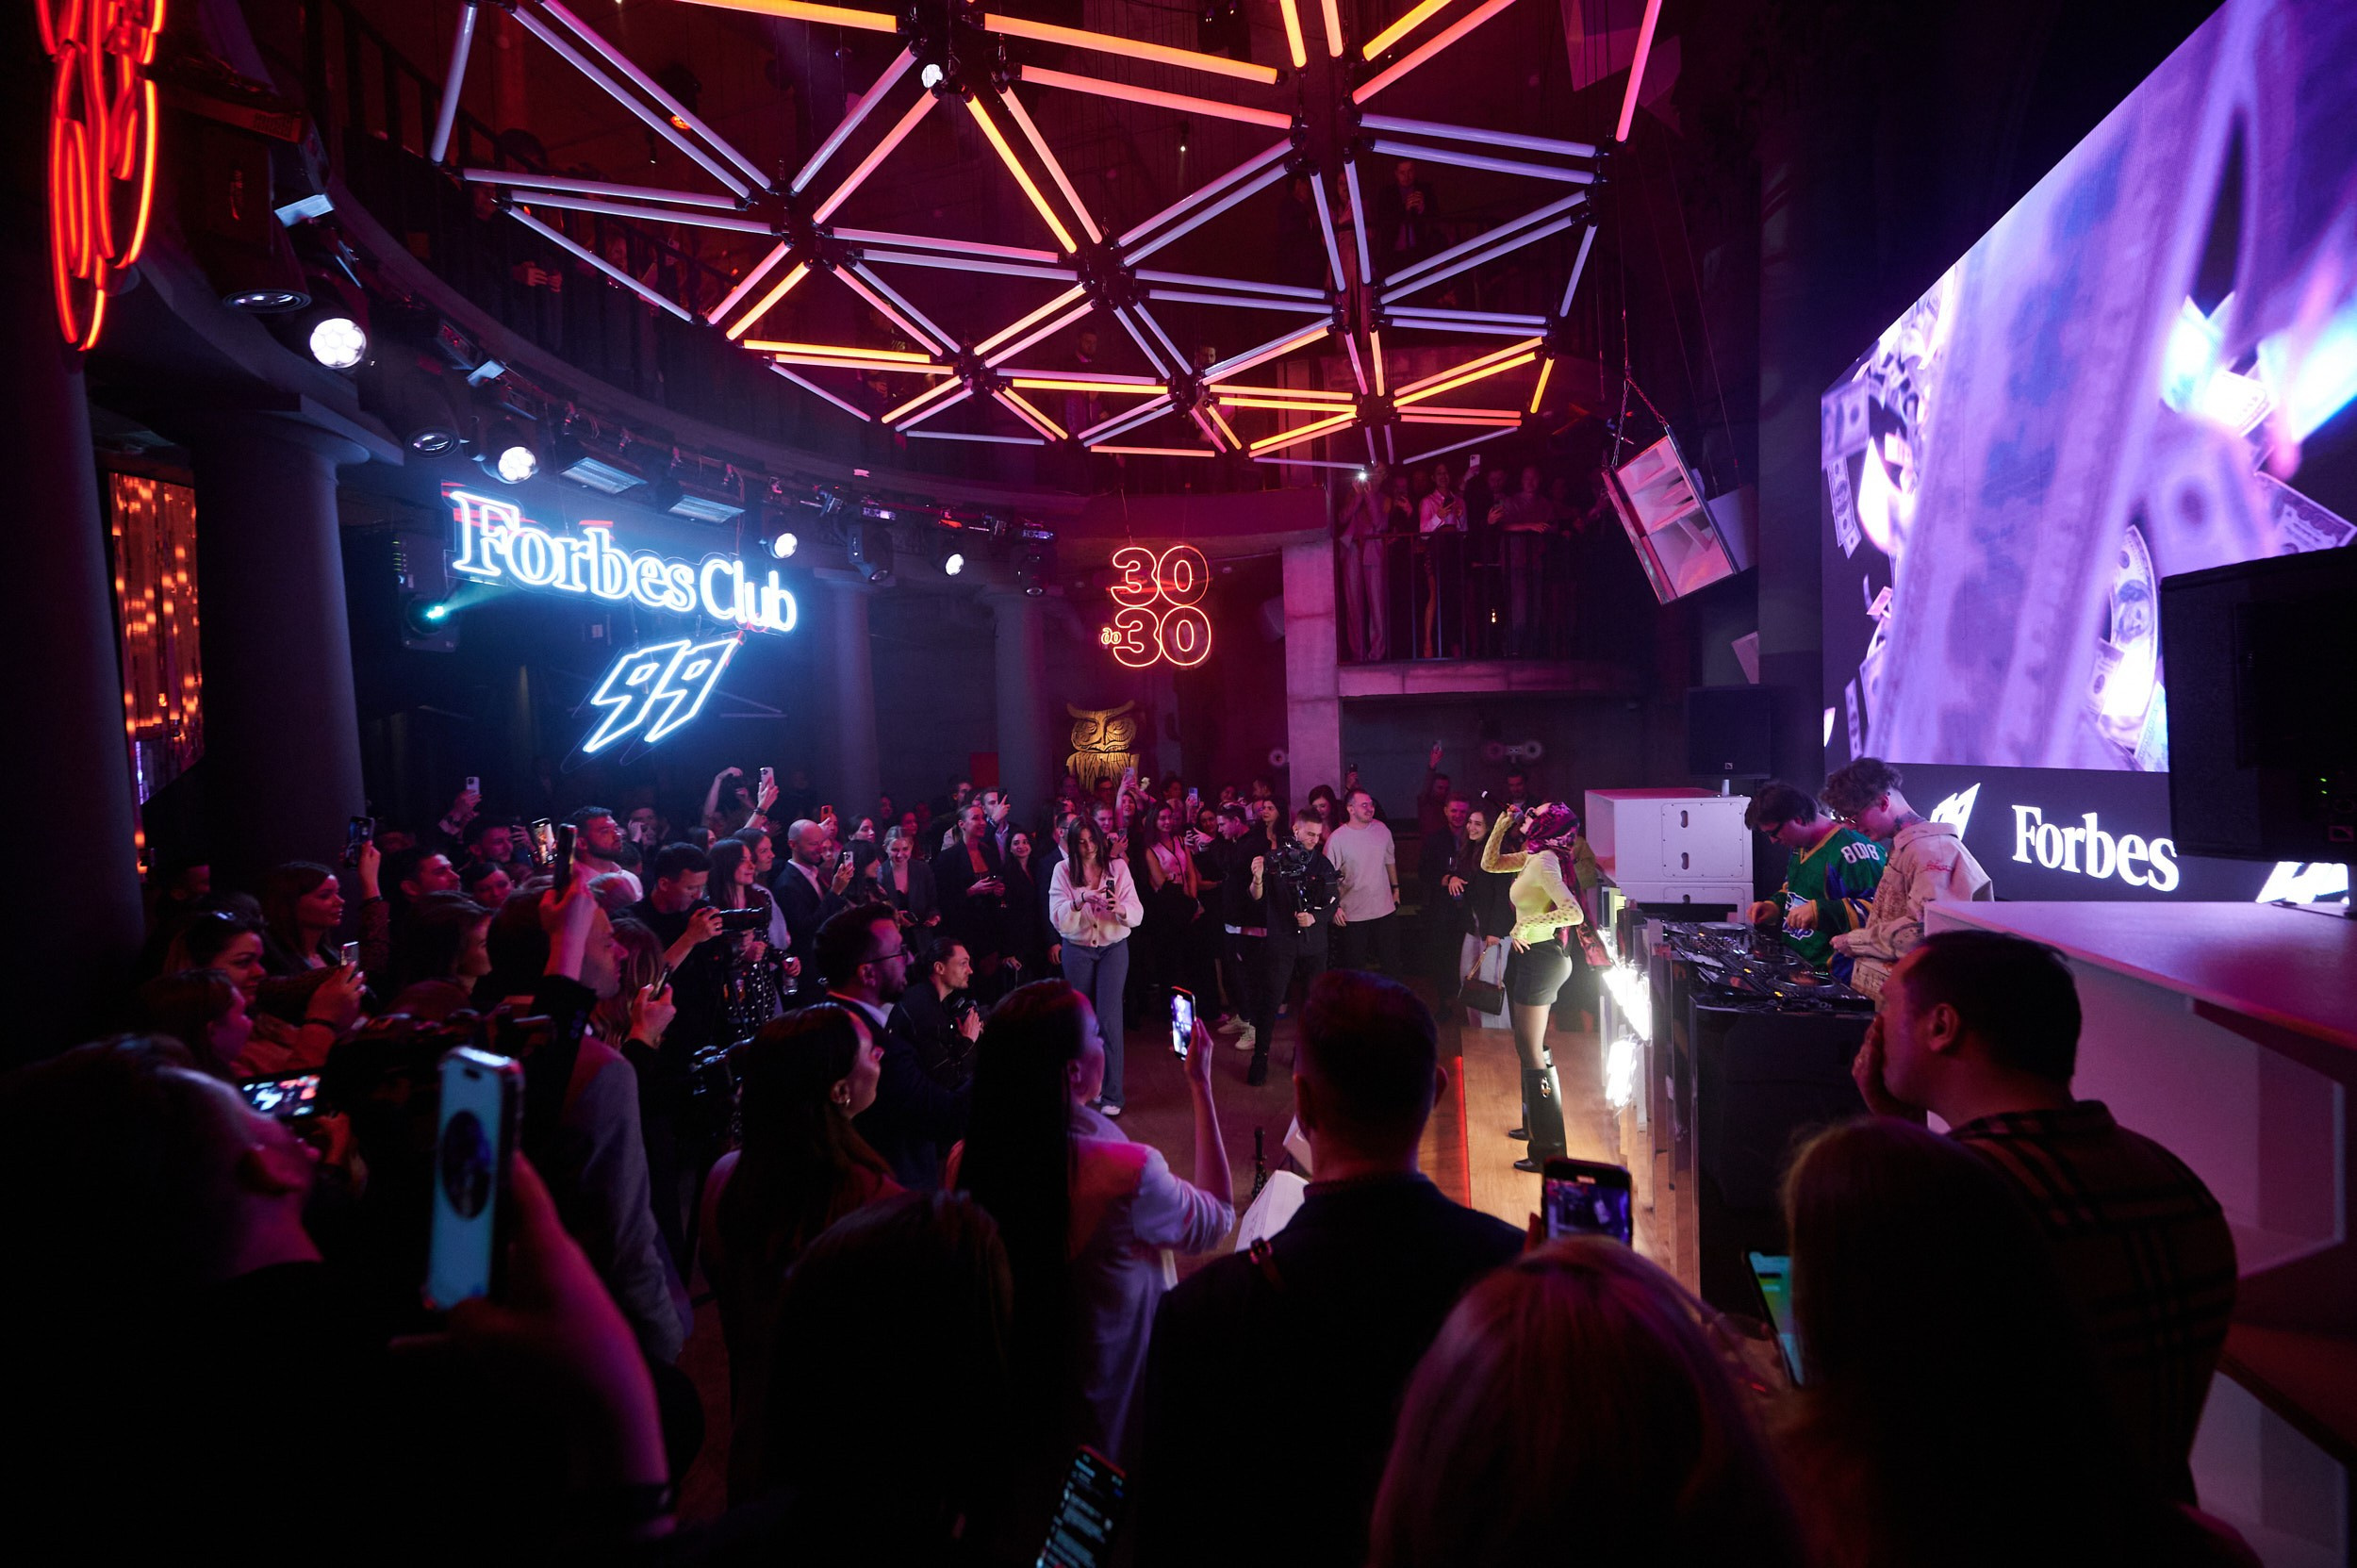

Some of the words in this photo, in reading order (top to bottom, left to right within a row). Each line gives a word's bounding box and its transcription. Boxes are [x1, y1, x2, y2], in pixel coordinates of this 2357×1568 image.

[450, 490, 697, 612] Forbes
[700, 558, 798, 632] Club
[1111, 545, 1210, 607] 30
[1113, 605, 1211, 668] 30
[2011, 804, 2180, 892] Forbes
